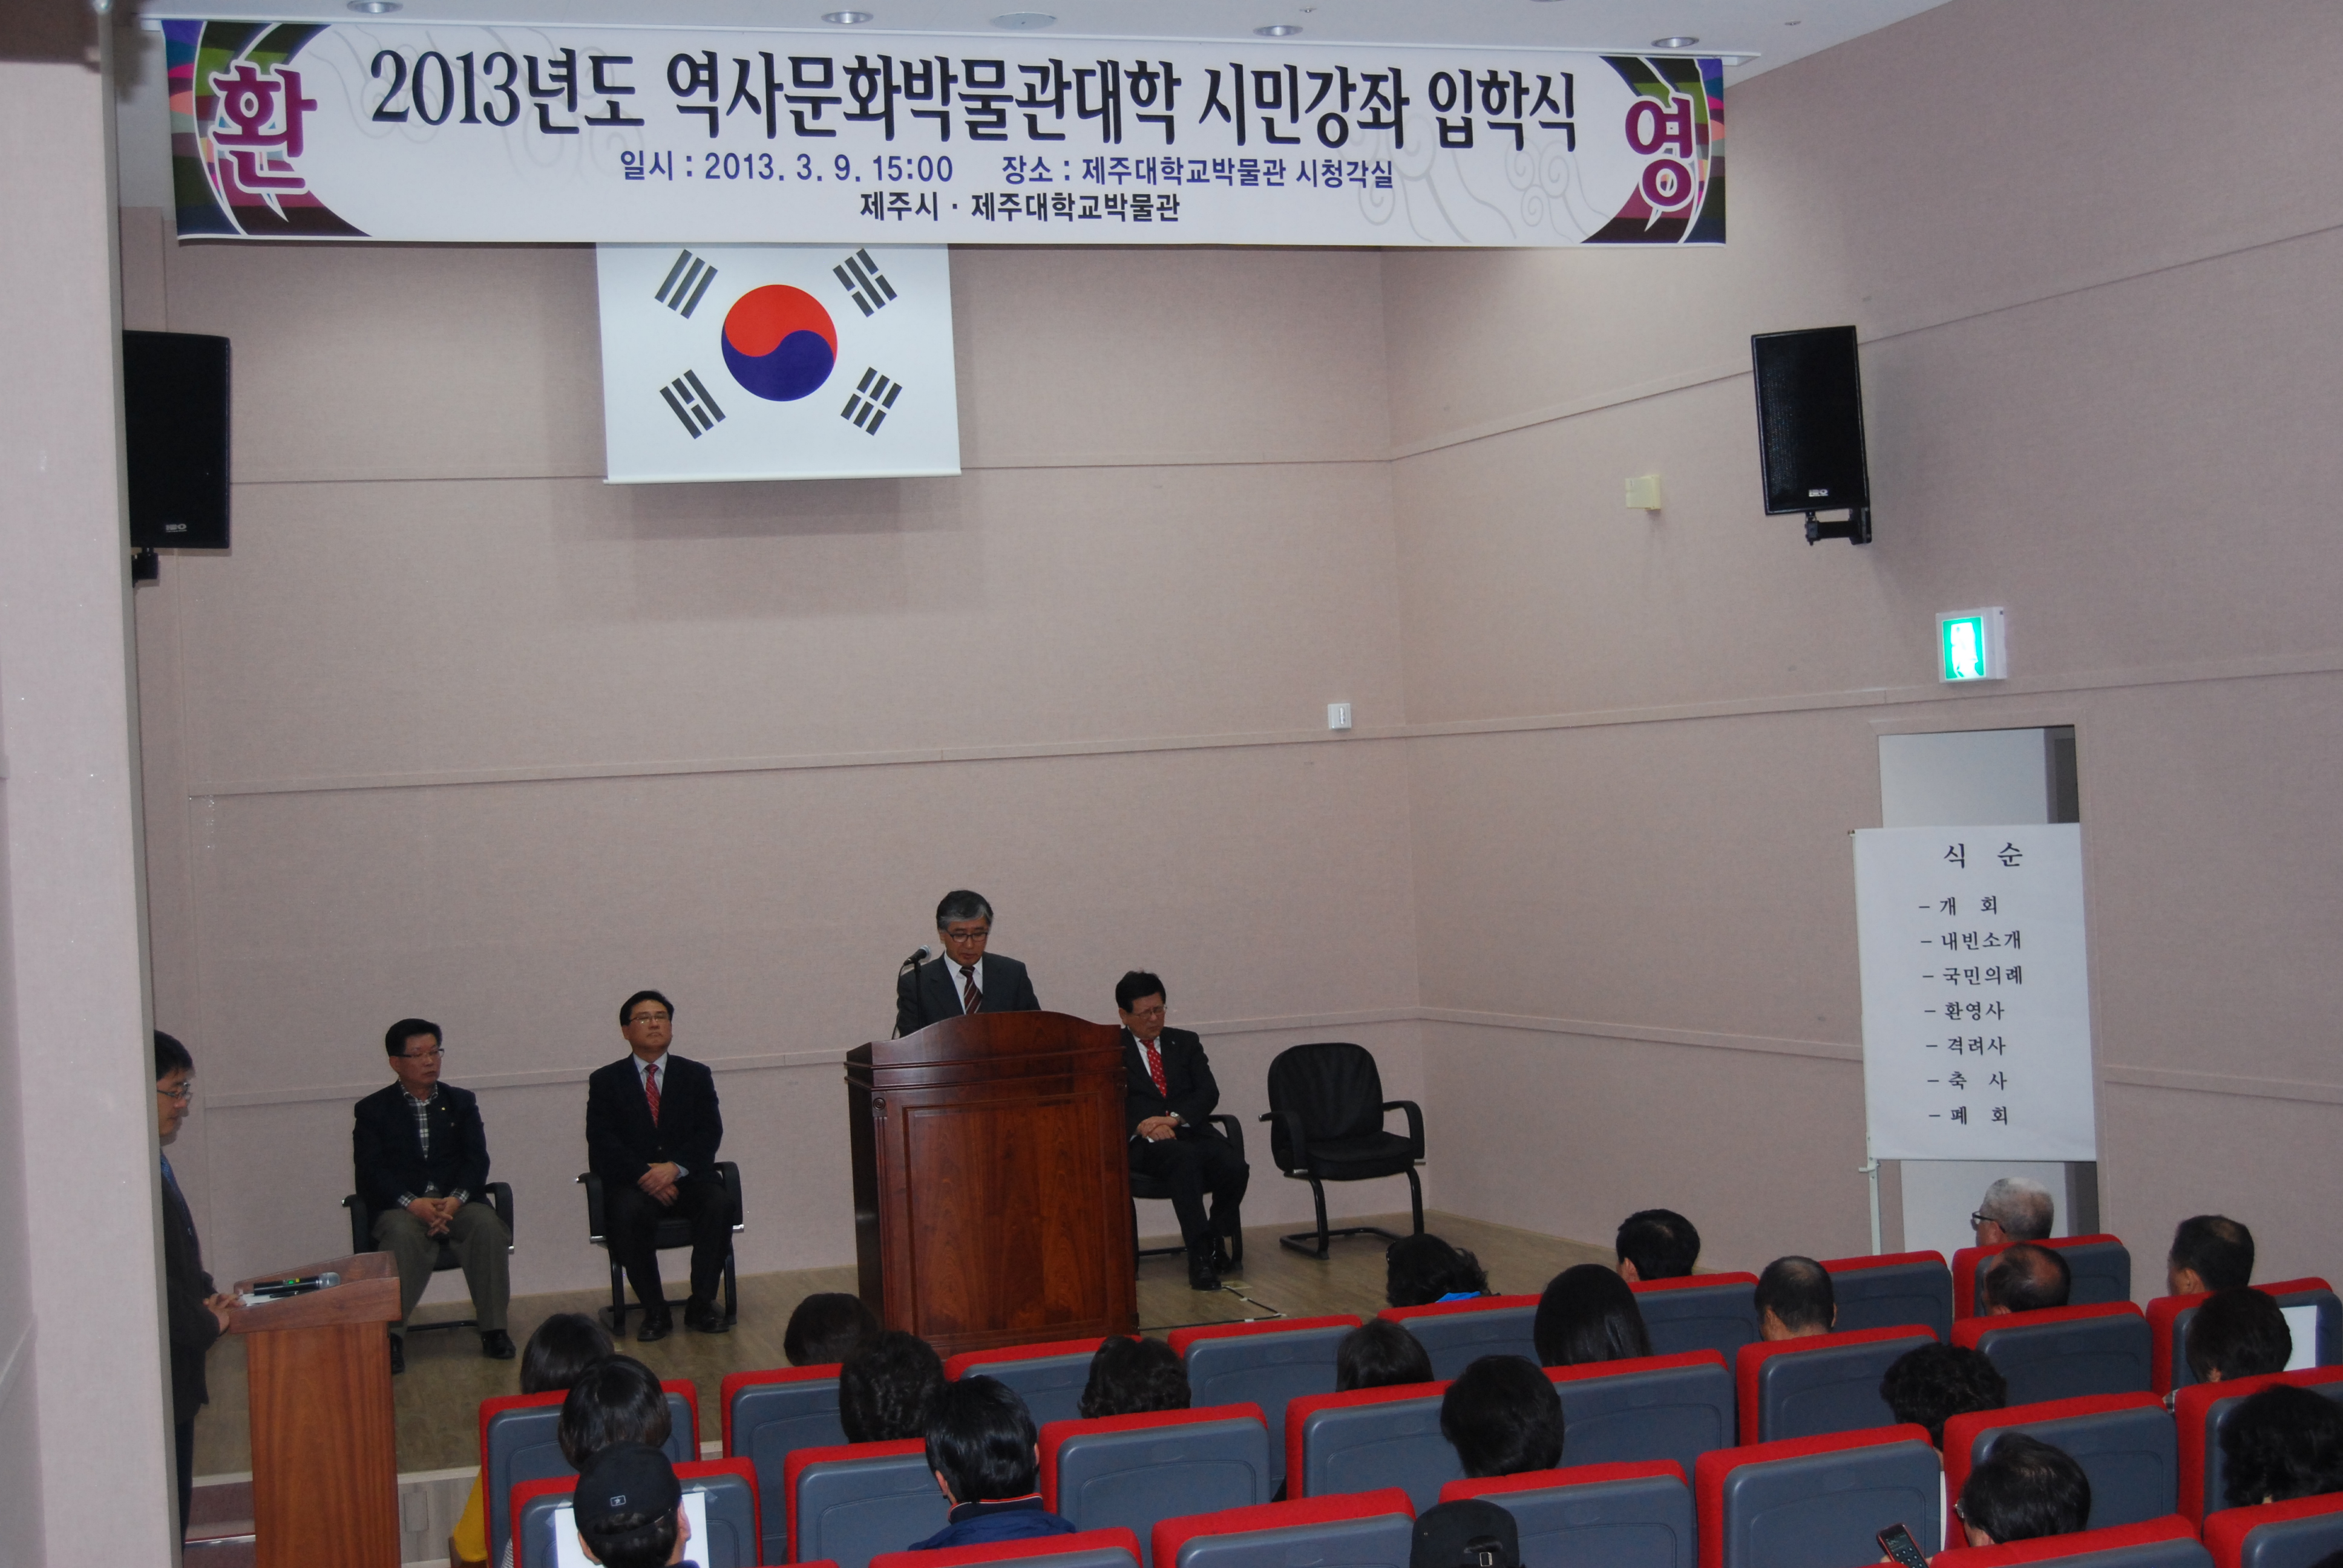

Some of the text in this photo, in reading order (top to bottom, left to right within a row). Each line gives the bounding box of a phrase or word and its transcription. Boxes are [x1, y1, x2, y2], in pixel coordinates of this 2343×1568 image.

[370, 47, 1576, 152] 2013년도 역사문화박물관대학 시민강좌 입학식
[212, 64, 318, 190] 환
[1624, 97, 1694, 207] 영
[620, 150, 673, 181] 일시
[705, 152, 784, 181] 2013.
[796, 153, 822, 181] 3.
[834, 154, 860, 182] 9.
[873, 155, 953, 182] 15:00
[1002, 155, 1053, 185] 장소
[1082, 156, 1286, 186] 제주대학교박물관
[1296, 159, 1393, 189] 시청각실
[860, 191, 938, 221] 제주시
[971, 192, 1180, 223] 제주대학교박물관
[1944, 842, 2023, 869] 식 순
[1940, 897, 1956, 916] 개
[1981, 895, 1997, 915] 회
[1941, 930, 2020, 951] 내빈소개
[1943, 965, 2022, 985] 국민의례
[1945, 1001, 2005, 1021] 환영사
[1948, 1036, 2006, 1056] 격려사
[1948, 1071, 1967, 1090] 축
[1989, 1071, 2007, 1091] 사
[1951, 1106, 1967, 1125] 폐
[1991, 1106, 2008, 1126] 회
